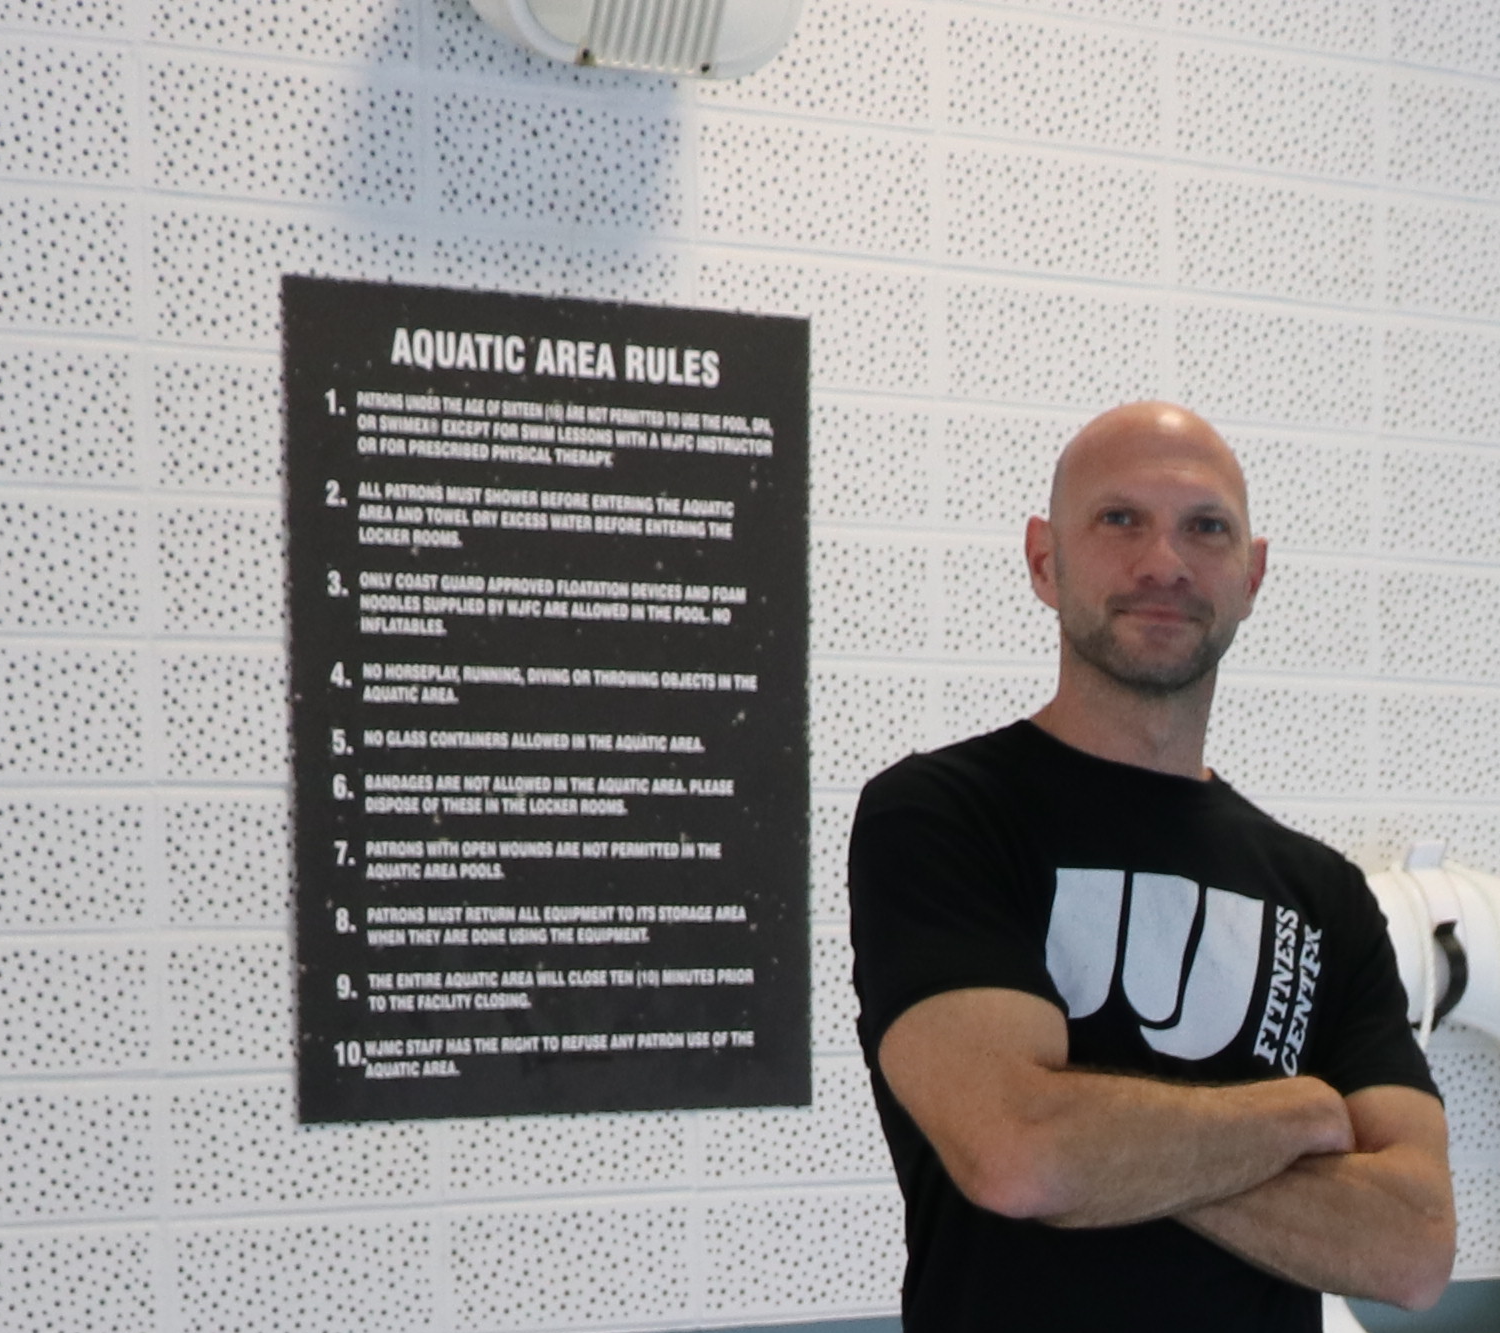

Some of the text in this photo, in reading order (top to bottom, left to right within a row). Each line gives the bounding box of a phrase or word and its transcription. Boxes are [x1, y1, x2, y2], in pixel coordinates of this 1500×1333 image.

[391, 328, 721, 388] AQUATIC AREA RULES
[324, 388, 347, 416] 1.
[325, 479, 735, 518] 2. ALL PATRONS MUST SHOWER BEFORE ENTERING THE AQUATIC
[327, 570, 747, 604] 3. ONLY COAST GUARD APPROVED FLOATATION DEVICES AND FOAM
[359, 594, 420, 613] NOODLES
[422, 596, 485, 616] SUPPLIED
[487, 599, 504, 617] BY
[543, 601, 568, 619] ARE
[571, 602, 629, 621] ALLOWED
[631, 604, 646, 622] IN
[647, 605, 672, 623] THE
[712, 607, 732, 625] NO
[330, 661, 352, 688] 4.
[362, 662, 383, 680] NO
[527, 667, 570, 686] DIVING
[572, 669, 592, 687] OR
[593, 669, 659, 689] THROWING
[661, 671, 715, 690] OBJECTS
[718, 673, 732, 691] IN
[733, 674, 758, 692] THE
[363, 685, 419, 704] AQUATIC
[331, 728, 354, 756] 5.
[363, 730, 384, 748] NO
[385, 730, 427, 748] GLASS
[429, 731, 508, 750] CONTAINERS
[511, 732, 570, 751] ALLOWED
[571, 733, 586, 751] IN
[588, 734, 613, 752] THE
[615, 734, 667, 752] AQUATIC
[332, 773, 355, 800] 6.
[364, 774, 433, 792] BANDAGES
[435, 775, 461, 793] ARE
[463, 775, 491, 793] NOT
[492, 776, 552, 794] ALLOWED
[553, 777, 568, 794] IN
[569, 777, 595, 794] THE
[597, 777, 649, 795] AQUATIC
[689, 778, 734, 796] PLEASE
[365, 796, 419, 814] DISPOSE
[422, 797, 439, 815] OF
[442, 797, 482, 815] THESE
[484, 797, 500, 815] IN
[501, 797, 527, 815] THE
[529, 798, 578, 816] LOCKER
[333, 840, 722, 866] 7. PATRONS WITH OPEN WOUNDS ARE NOT PERMITTED IN THE
[366, 863, 421, 880] AQUATIC
[423, 863, 458, 880] AREA
[335, 905, 747, 934] 8. PATRONS MUST RETURN ALL EQUIPMENT TO ITS STORAGE AREA
[367, 928, 406, 946] WHEN
[408, 928, 441, 946] THEY
[443, 928, 469, 946] ARE
[471, 928, 506, 945] DONE
[508, 927, 548, 945] USING
[550, 927, 575, 945] THE
[336, 973, 358, 1000] 9.
[368, 973, 394, 990] THE
[396, 972, 442, 990] ENTIRE
[444, 971, 499, 989] AQUATIC
[501, 971, 534, 988] AREA
[536, 971, 565, 988] WILL
[567, 970, 607, 988] CLOSE
[609, 970, 634, 987] TEN
[662, 969, 715, 986] MINUTES
[717, 968, 754, 986] PRIOR
[1253, 905, 1299, 1065] FITNESS
[368, 995, 386, 1012] TO
[388, 995, 415, 1012] THE
[417, 994, 472, 1011] FACILITY
[333, 1040, 368, 1067] 10.
